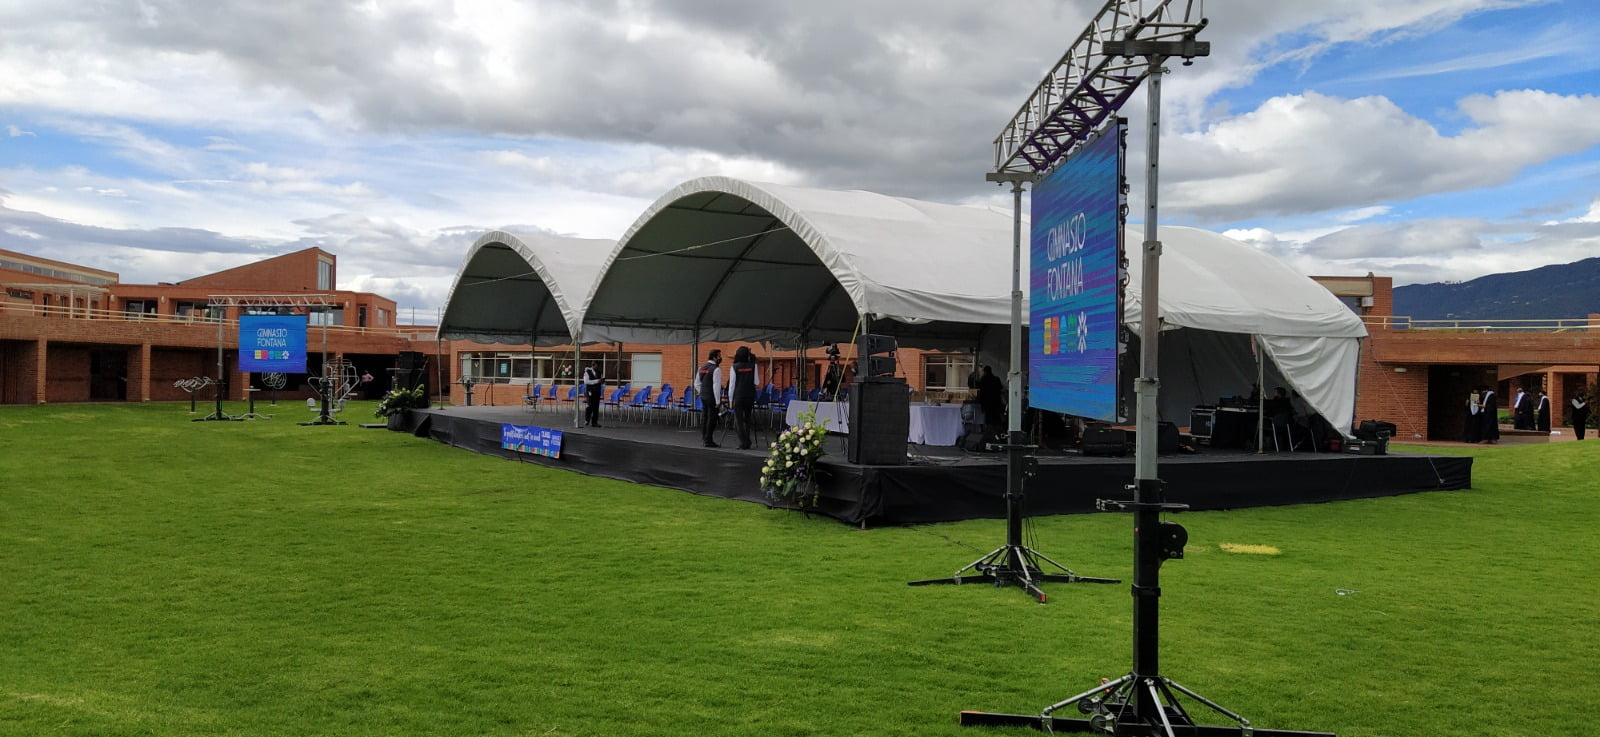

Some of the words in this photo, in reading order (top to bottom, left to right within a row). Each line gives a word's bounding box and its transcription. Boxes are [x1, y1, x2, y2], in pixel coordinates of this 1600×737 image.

[1047, 212, 1086, 262] GIMNASIO
[1047, 256, 1084, 302] FONTANA
[256, 328, 288, 338] GIMNASIO
[257, 338, 287, 347] FONTANA
